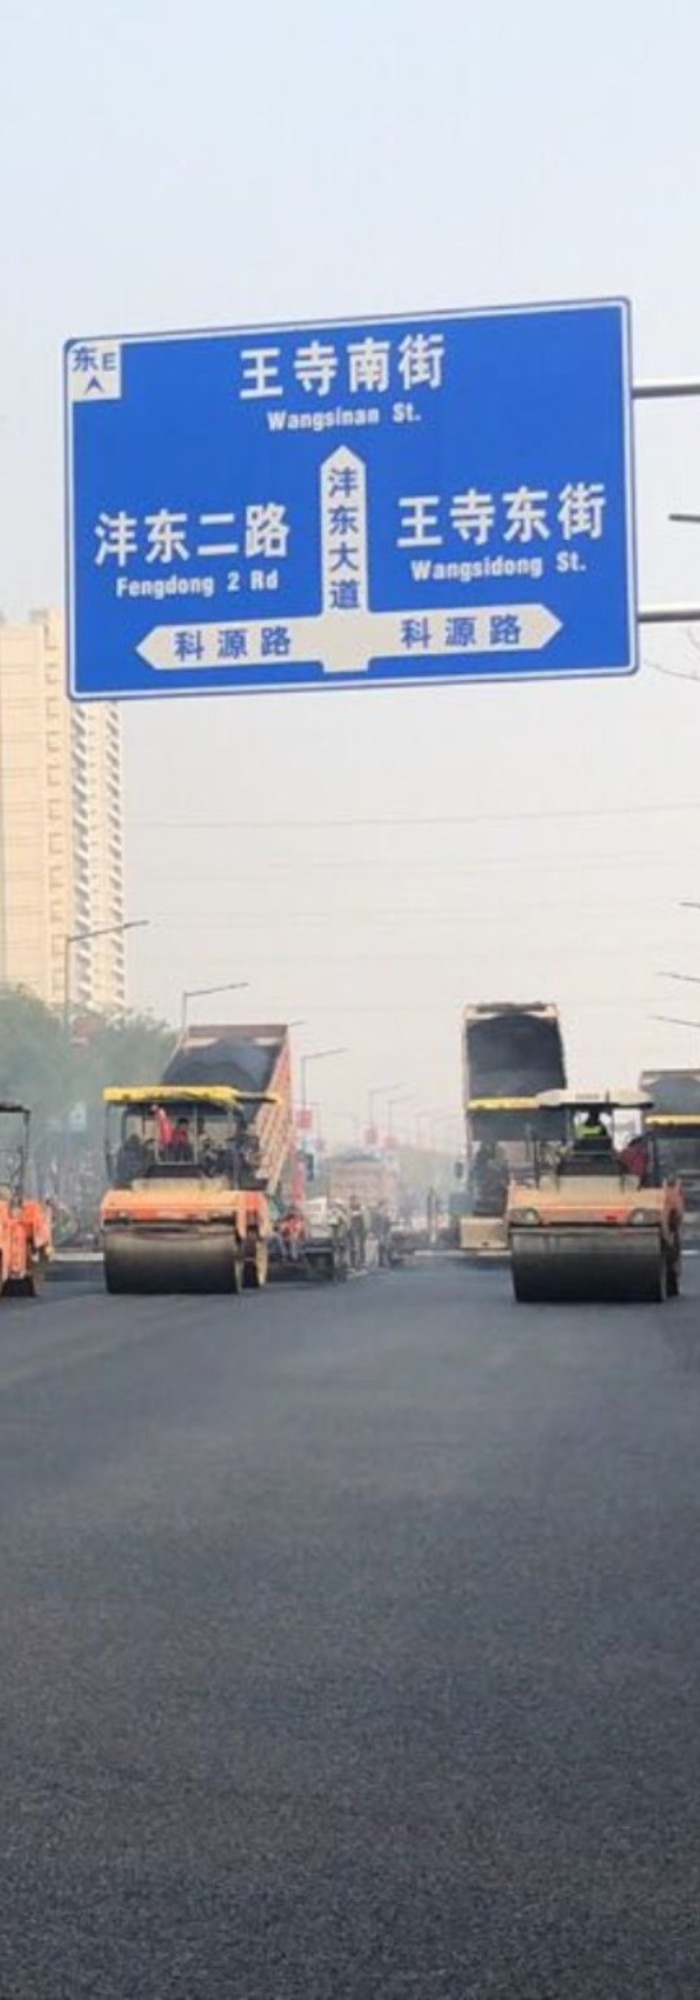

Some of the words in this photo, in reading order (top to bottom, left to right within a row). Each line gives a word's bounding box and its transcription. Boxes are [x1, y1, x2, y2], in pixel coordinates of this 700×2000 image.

[239, 333, 445, 398] 王寺南街
[267, 408, 379, 431] Wangsinan
[393, 402, 421, 423] St.
[397, 482, 606, 547] 王寺东街
[95, 502, 290, 565] 沣东二路
[328, 466, 360, 609] 沣东大道
[116, 575, 214, 598] Fengdong
[227, 573, 240, 591] 2
[251, 570, 278, 590] Rd
[411, 556, 543, 582] Wangsidong
[556, 552, 586, 574] St.
[173, 625, 291, 660] 科源路
[400, 613, 521, 648] 科源路
